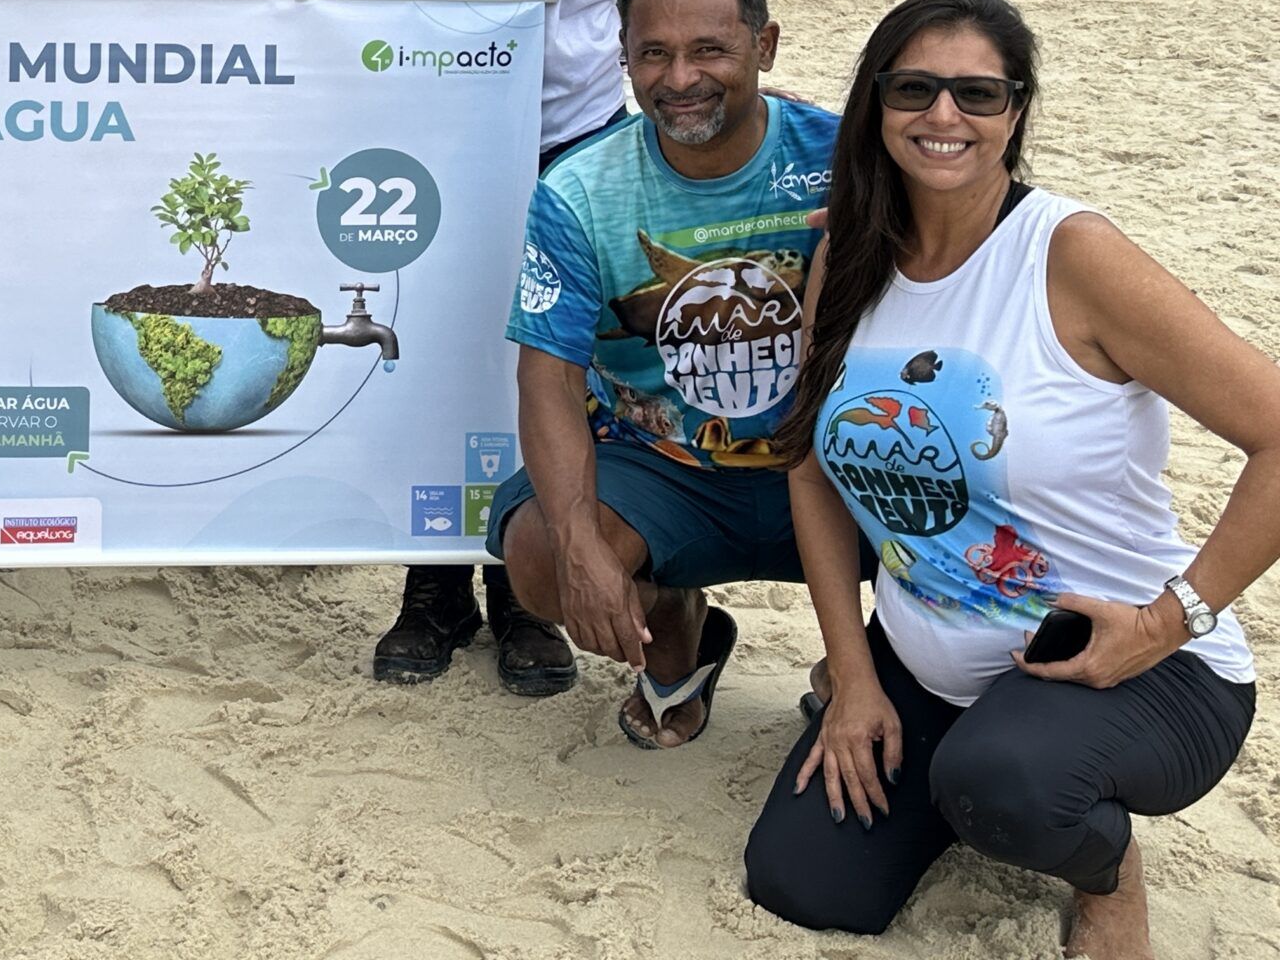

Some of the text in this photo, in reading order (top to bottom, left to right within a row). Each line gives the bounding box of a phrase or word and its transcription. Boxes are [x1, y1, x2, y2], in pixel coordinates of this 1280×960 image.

[9, 42, 296, 85] MUNDIAL
[339, 176, 418, 226] 22
[694, 213, 808, 243] @mardeconheci
[339, 229, 419, 245] DE MARÇO
[721, 324, 743, 342] de
[22, 394, 70, 410] ÁGUA
[44, 415, 58, 429] O
[469, 435, 479, 449] 6
[415, 489, 428, 501] 14
[469, 489, 481, 500] 15
[4, 517, 77, 527] INSTITUTO ECOLÓGICO
